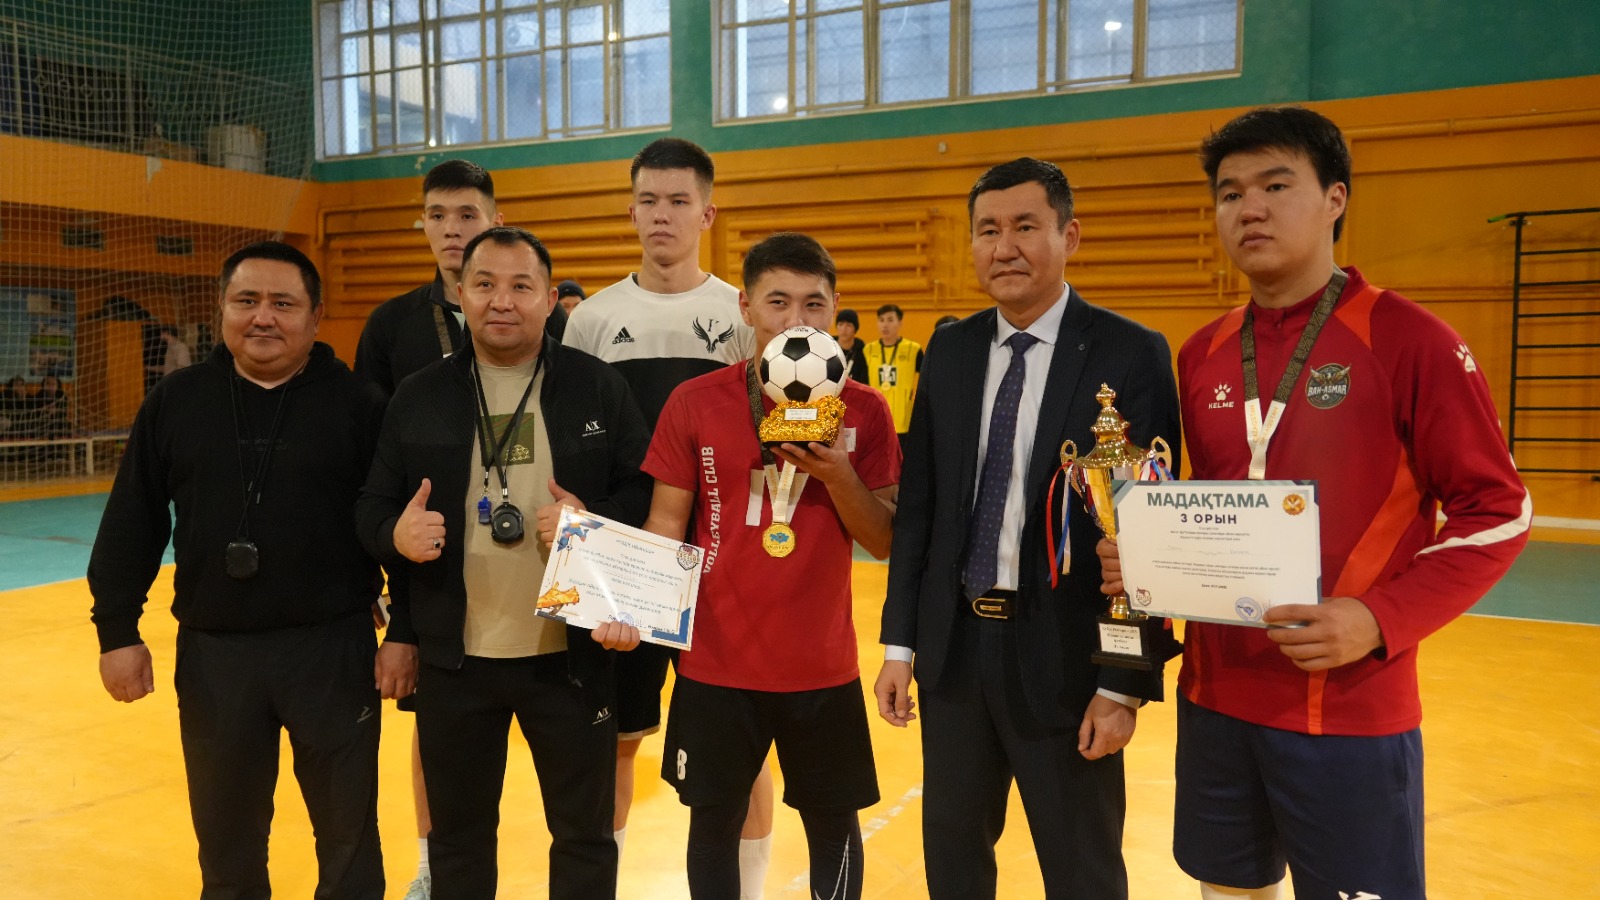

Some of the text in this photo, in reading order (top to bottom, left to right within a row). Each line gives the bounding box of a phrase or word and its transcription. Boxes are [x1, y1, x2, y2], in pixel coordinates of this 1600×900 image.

[612, 337, 635, 345] adidas
[1208, 401, 1234, 409] KELME
[1147, 492, 1270, 510] МАДАҚТАМА
[701, 446, 721, 574] VOLLEYBALL CLUB
[1180, 513, 1237, 524] 3 ОРЫН
